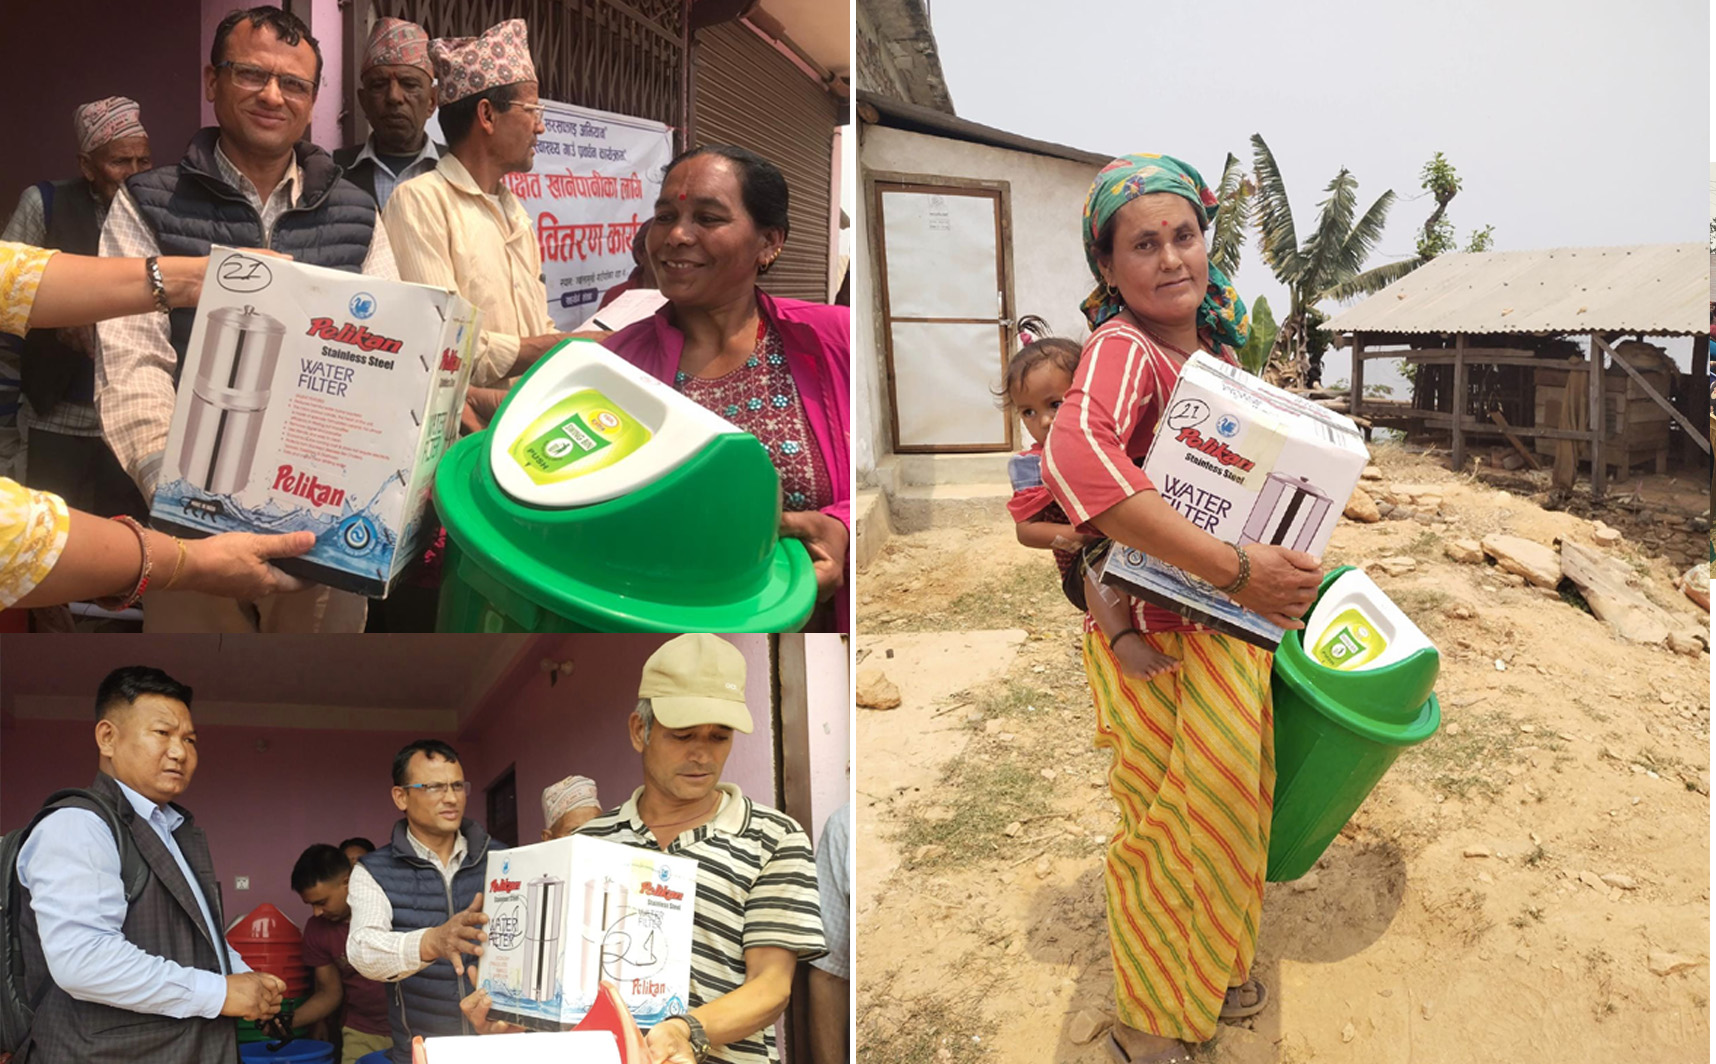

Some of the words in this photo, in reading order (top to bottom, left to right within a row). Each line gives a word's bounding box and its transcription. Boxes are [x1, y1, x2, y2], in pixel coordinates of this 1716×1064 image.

[545, 167, 618, 199] खानेपानीका
[620, 171, 643, 200] लागि
[537, 211, 603, 263] वितरण
[223, 260, 262, 280] 21
[305, 317, 404, 354] Pelikan
[301, 357, 355, 383] WATER
[321, 345, 367, 365] Stainless
[368, 355, 395, 371] Steel
[298, 373, 348, 398] FILTER
[1169, 402, 1200, 419] 21
[527, 447, 550, 470] PUSH
[1175, 427, 1256, 473] Pelikan
[1184, 452, 1223, 476] Stainless
[1222, 468, 1246, 486] Steel
[272, 464, 345, 507] Pelikan
[1164, 473, 1233, 519] WATER
[632, 978, 666, 997] Pelikan
